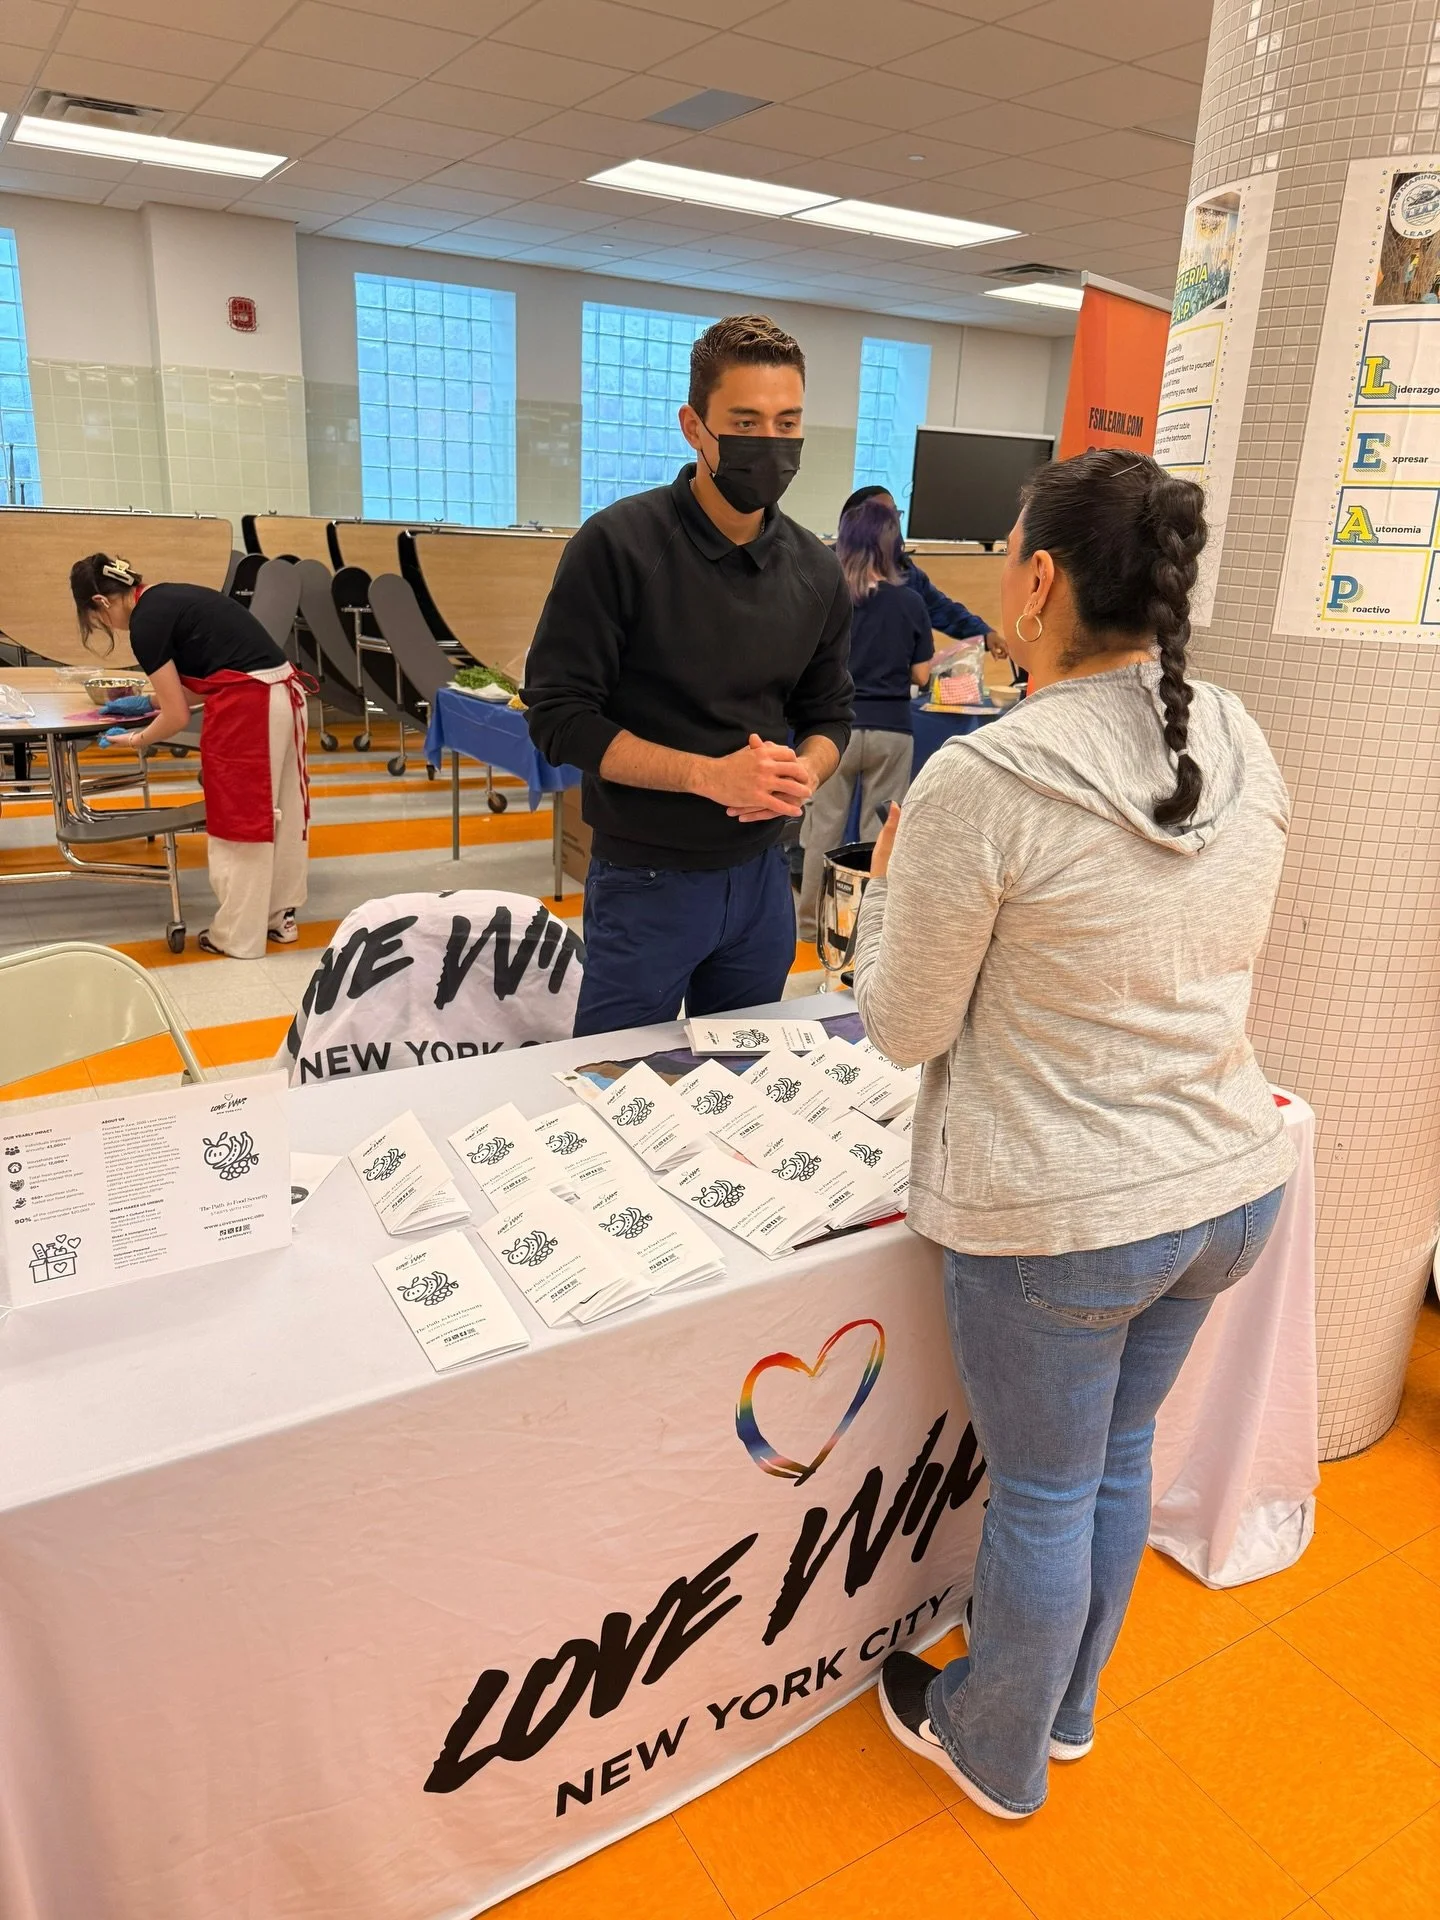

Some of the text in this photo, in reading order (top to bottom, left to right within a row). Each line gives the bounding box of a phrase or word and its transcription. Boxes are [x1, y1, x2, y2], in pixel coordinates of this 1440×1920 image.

[1088, 407, 1144, 438] FSNLEARN.COM
[300, 1041, 391, 1084] NEW
[14, 1216, 32, 1224] 90%
[423, 1532, 759, 1794] LOVE
[556, 1587, 953, 1817] NEW YORK CITY
